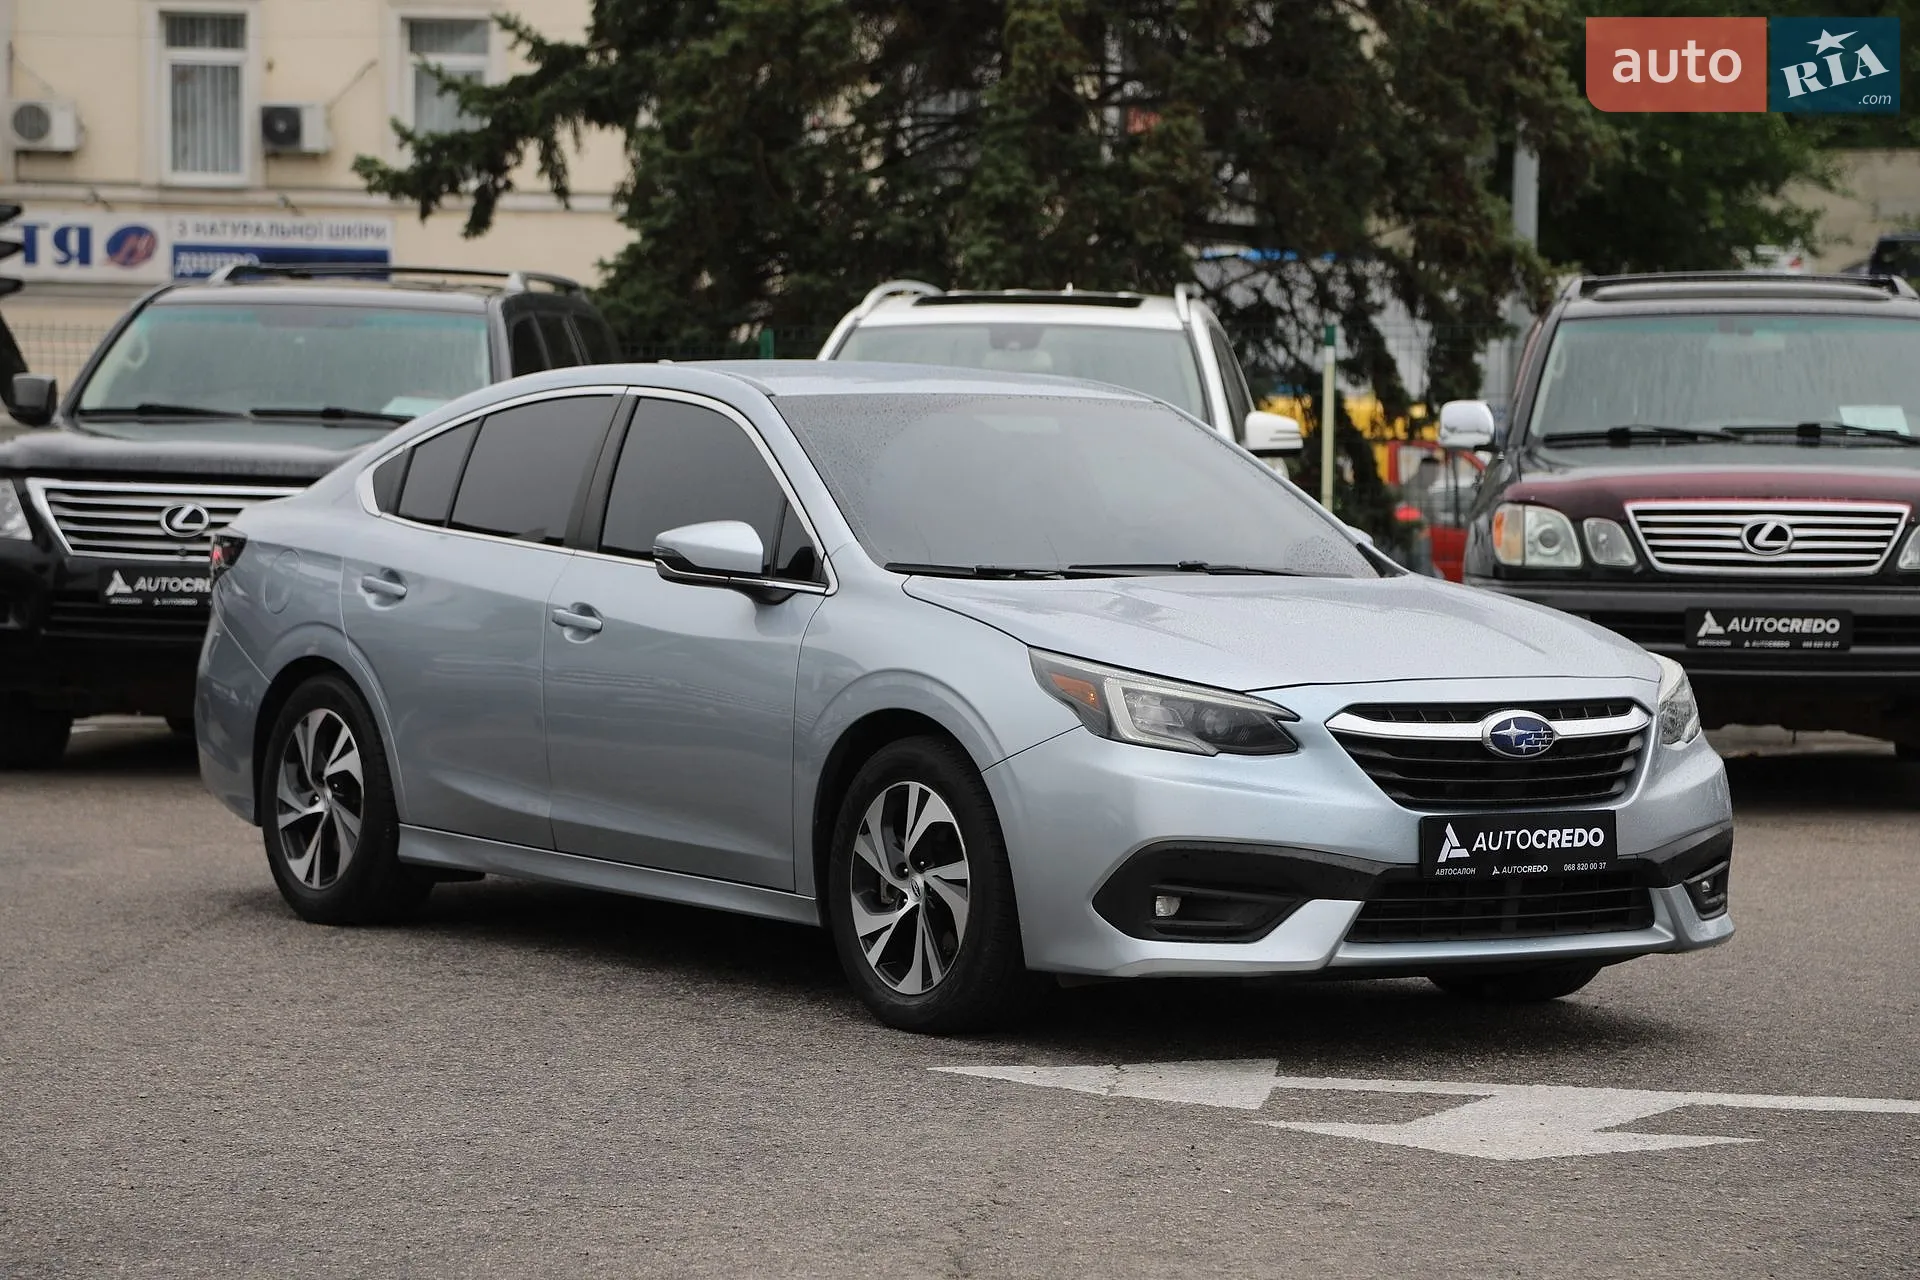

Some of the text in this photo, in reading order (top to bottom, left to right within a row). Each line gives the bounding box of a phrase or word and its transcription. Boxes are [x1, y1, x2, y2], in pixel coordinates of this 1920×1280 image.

[194, 218, 324, 241] НАТУРАЛЬНОЇ
[327, 222, 387, 240] ШКІРИ
[1727, 617, 1840, 634] AUTOCREDO
[1472, 827, 1605, 852] AUTOCREDO
[1435, 867, 1476, 876] АВТОСАЛОН
[1502, 865, 1548, 874] AUTOCREDO
[1563, 861, 1607, 871] 068 820 00 37
